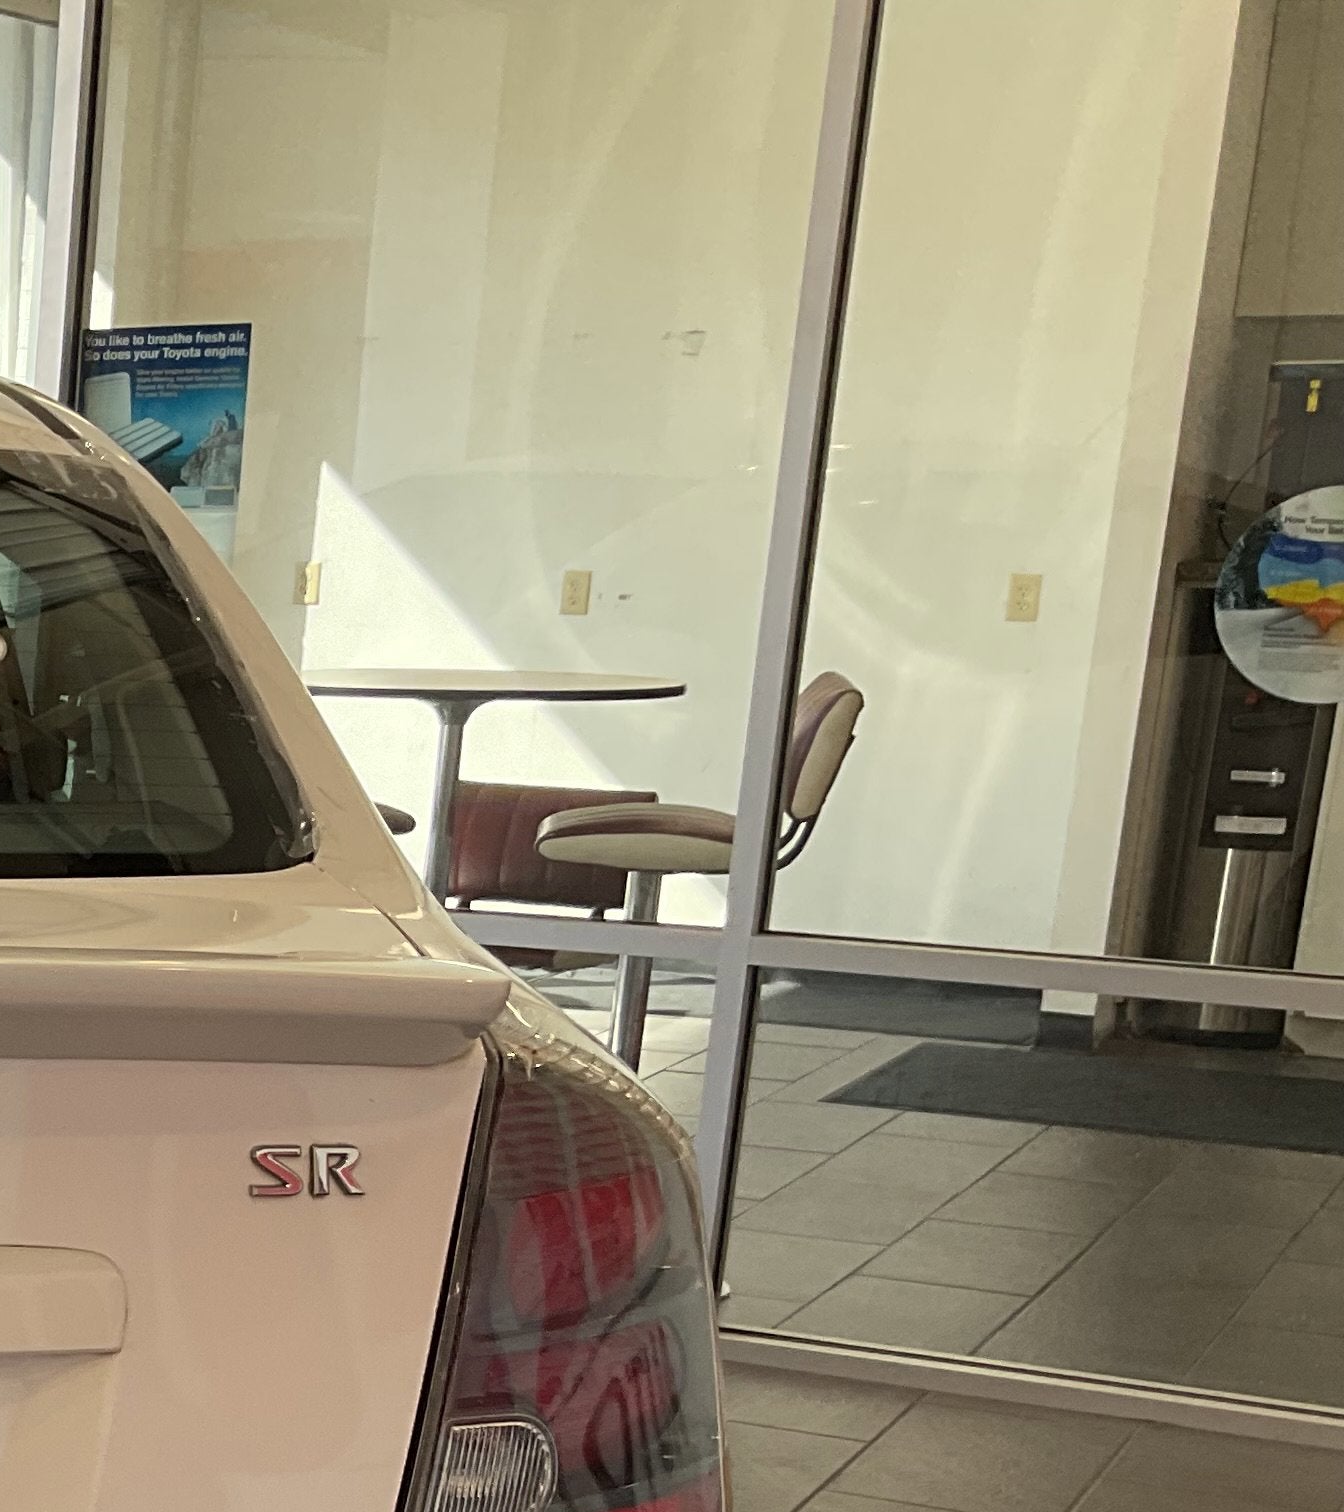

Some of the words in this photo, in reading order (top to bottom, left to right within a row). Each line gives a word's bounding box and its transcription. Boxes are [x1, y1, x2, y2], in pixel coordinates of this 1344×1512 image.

[86, 334, 106, 347] You
[108, 335, 130, 346] like
[132, 335, 145, 346] to
[147, 332, 193, 345] breathe
[195, 331, 226, 344] fresh
[85, 349, 101, 361] So
[102, 349, 132, 361] does
[133, 349, 160, 362] your
[162, 346, 202, 360] Toyota
[204, 345, 249, 360] engine.
[248, 1143, 366, 1198] SR
